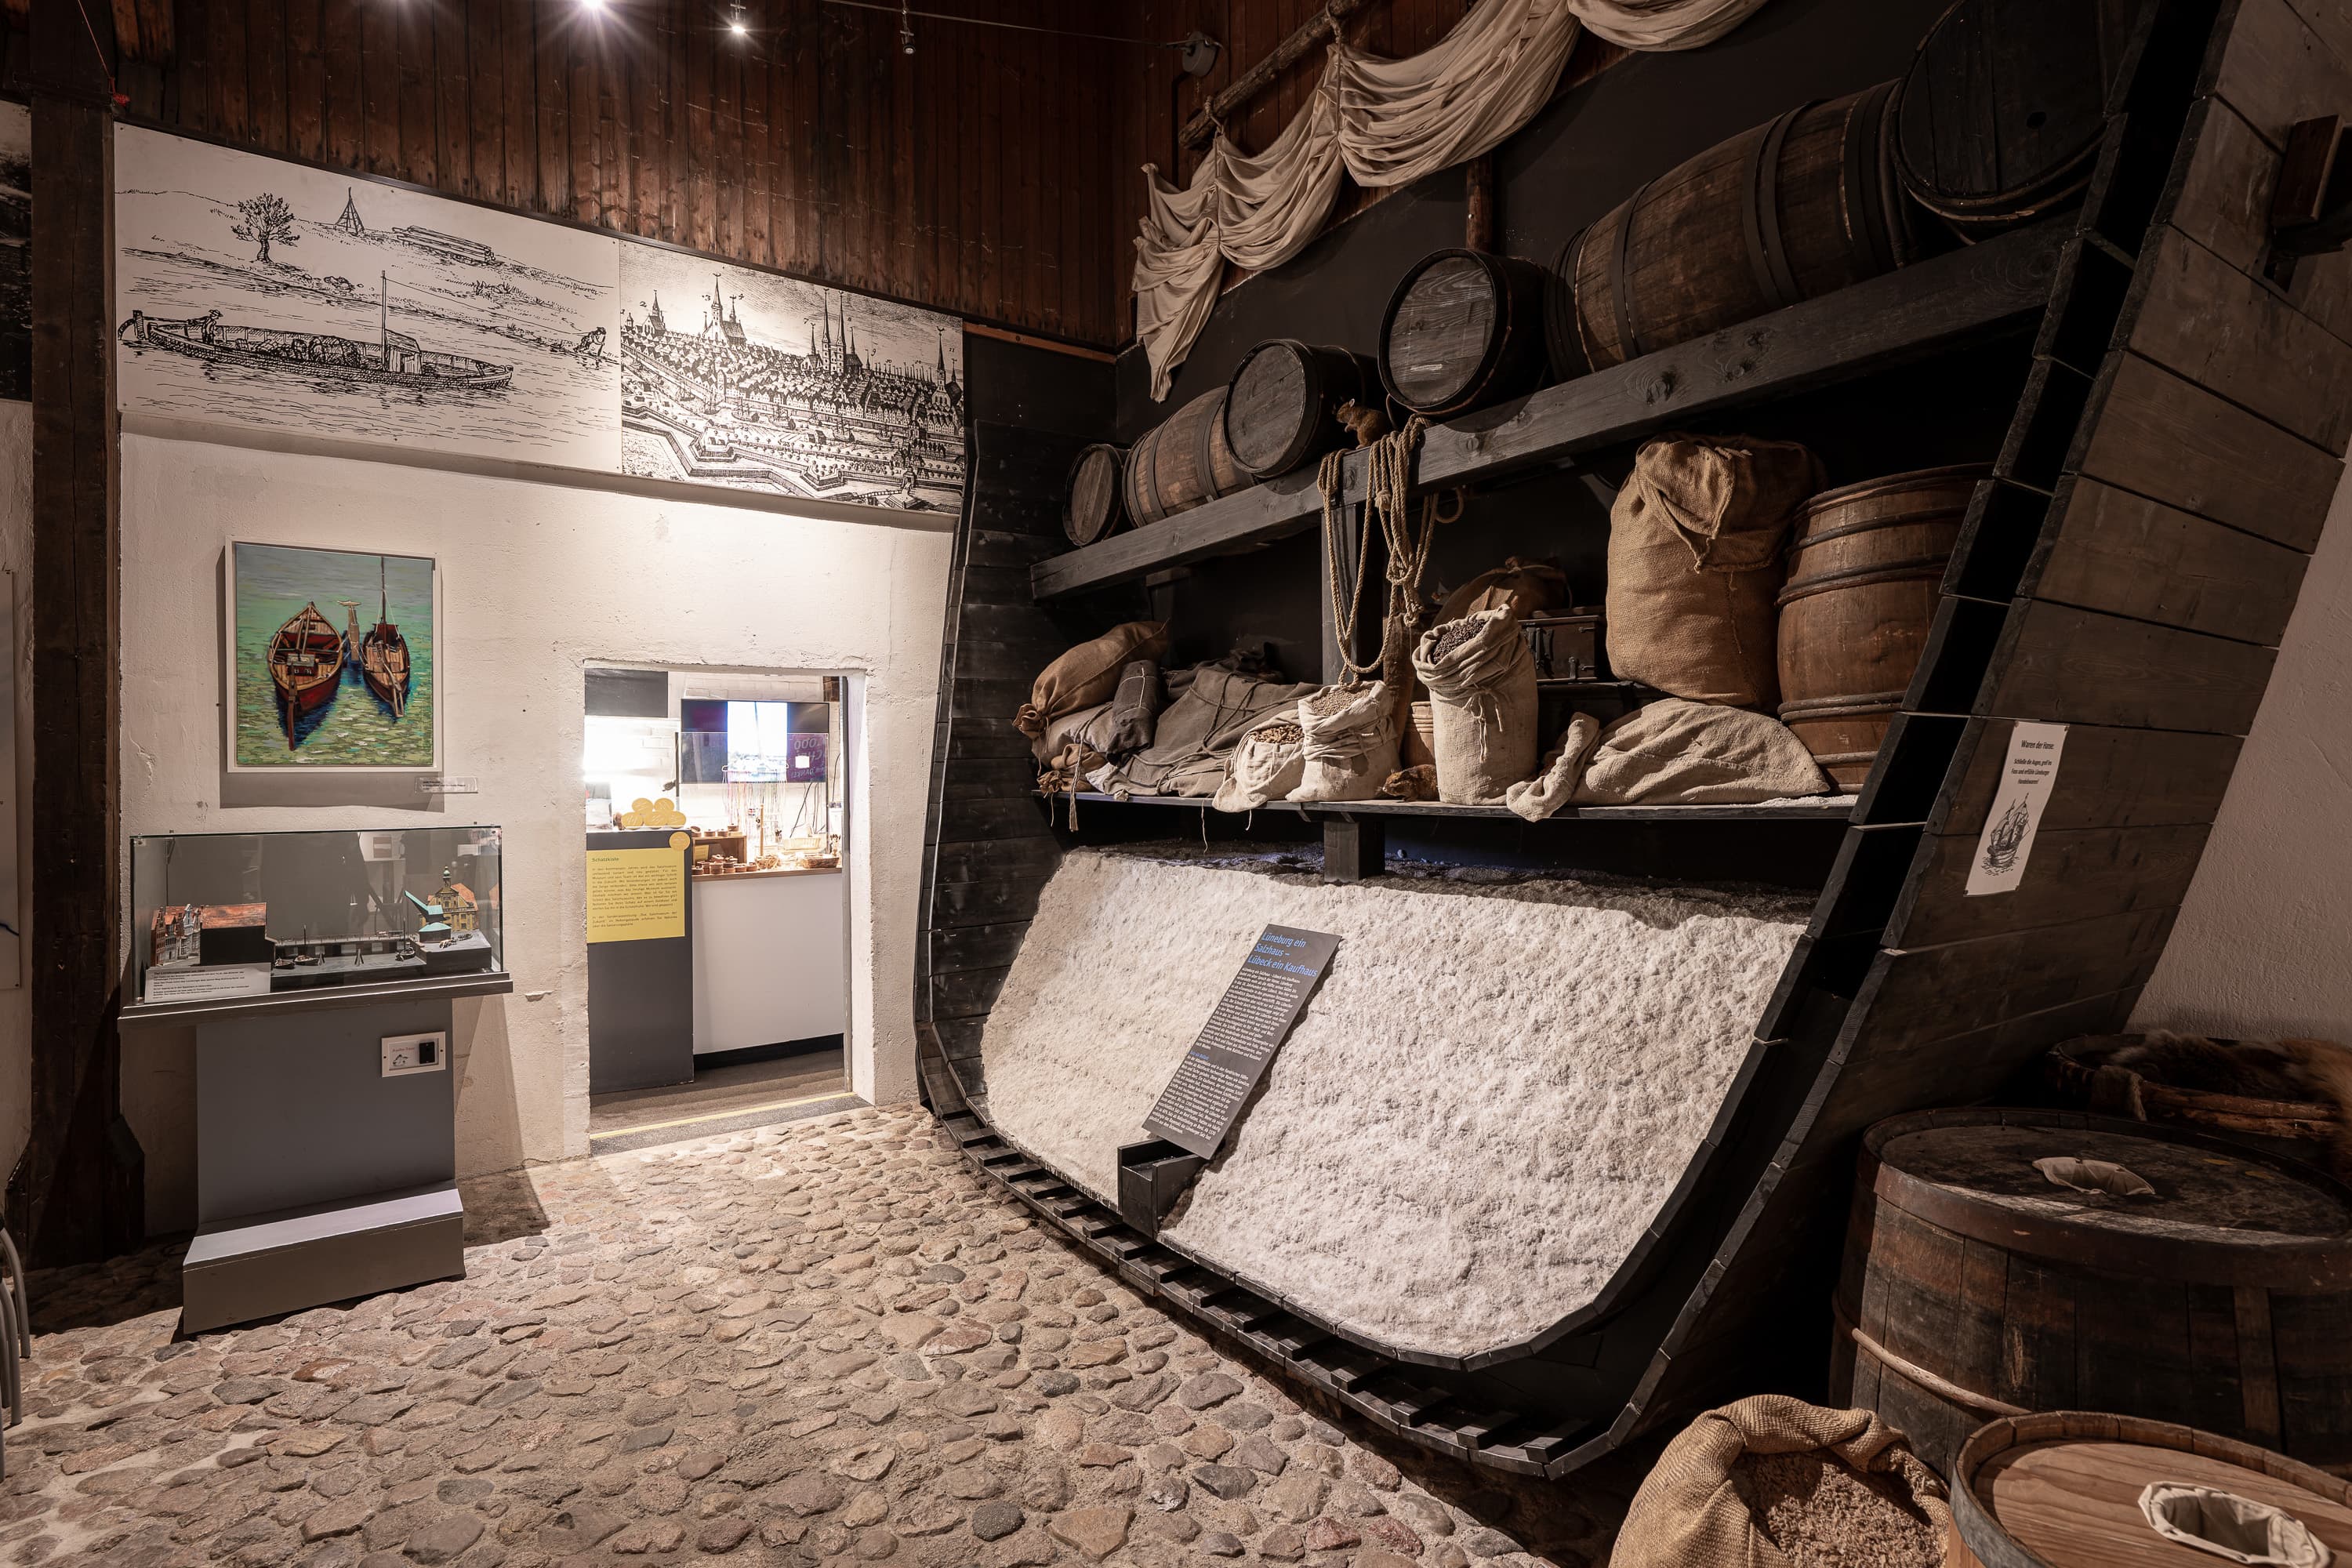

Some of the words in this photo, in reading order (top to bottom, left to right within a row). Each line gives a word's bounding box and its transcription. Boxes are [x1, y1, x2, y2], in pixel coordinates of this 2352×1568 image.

[2021, 740, 2036, 748] Waren
[1261, 932, 1293, 947] Lüneburg
[1294, 938, 1306, 947] ein
[1254, 943, 1284, 956] Salzhaus
[1248, 955, 1272, 967] Lübeck
[1272, 960, 1284, 970] ein
[1284, 962, 1318, 977] Kaufhaus
